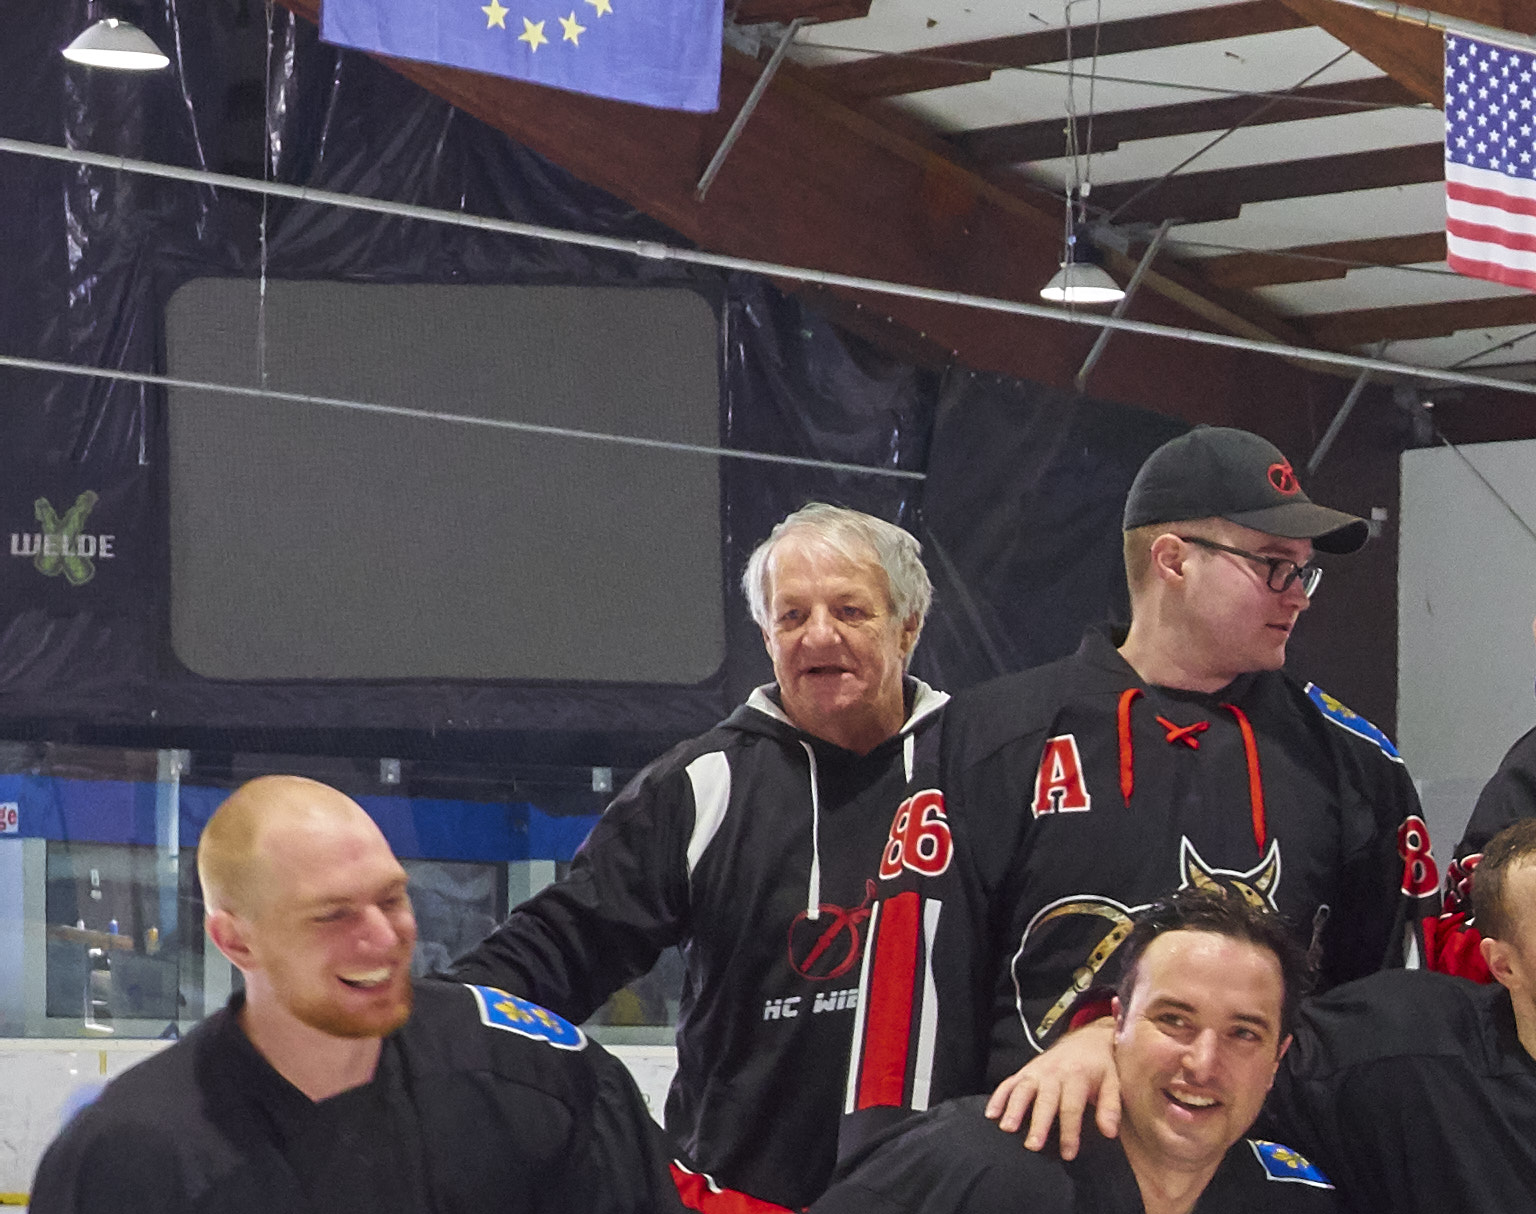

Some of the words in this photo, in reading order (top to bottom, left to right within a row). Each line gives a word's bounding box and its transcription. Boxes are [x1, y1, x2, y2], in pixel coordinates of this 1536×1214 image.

[11, 533, 115, 558] WELDE
[1031, 734, 1090, 818] A
[880, 789, 953, 880] 86
[763, 997, 801, 1020] HC
